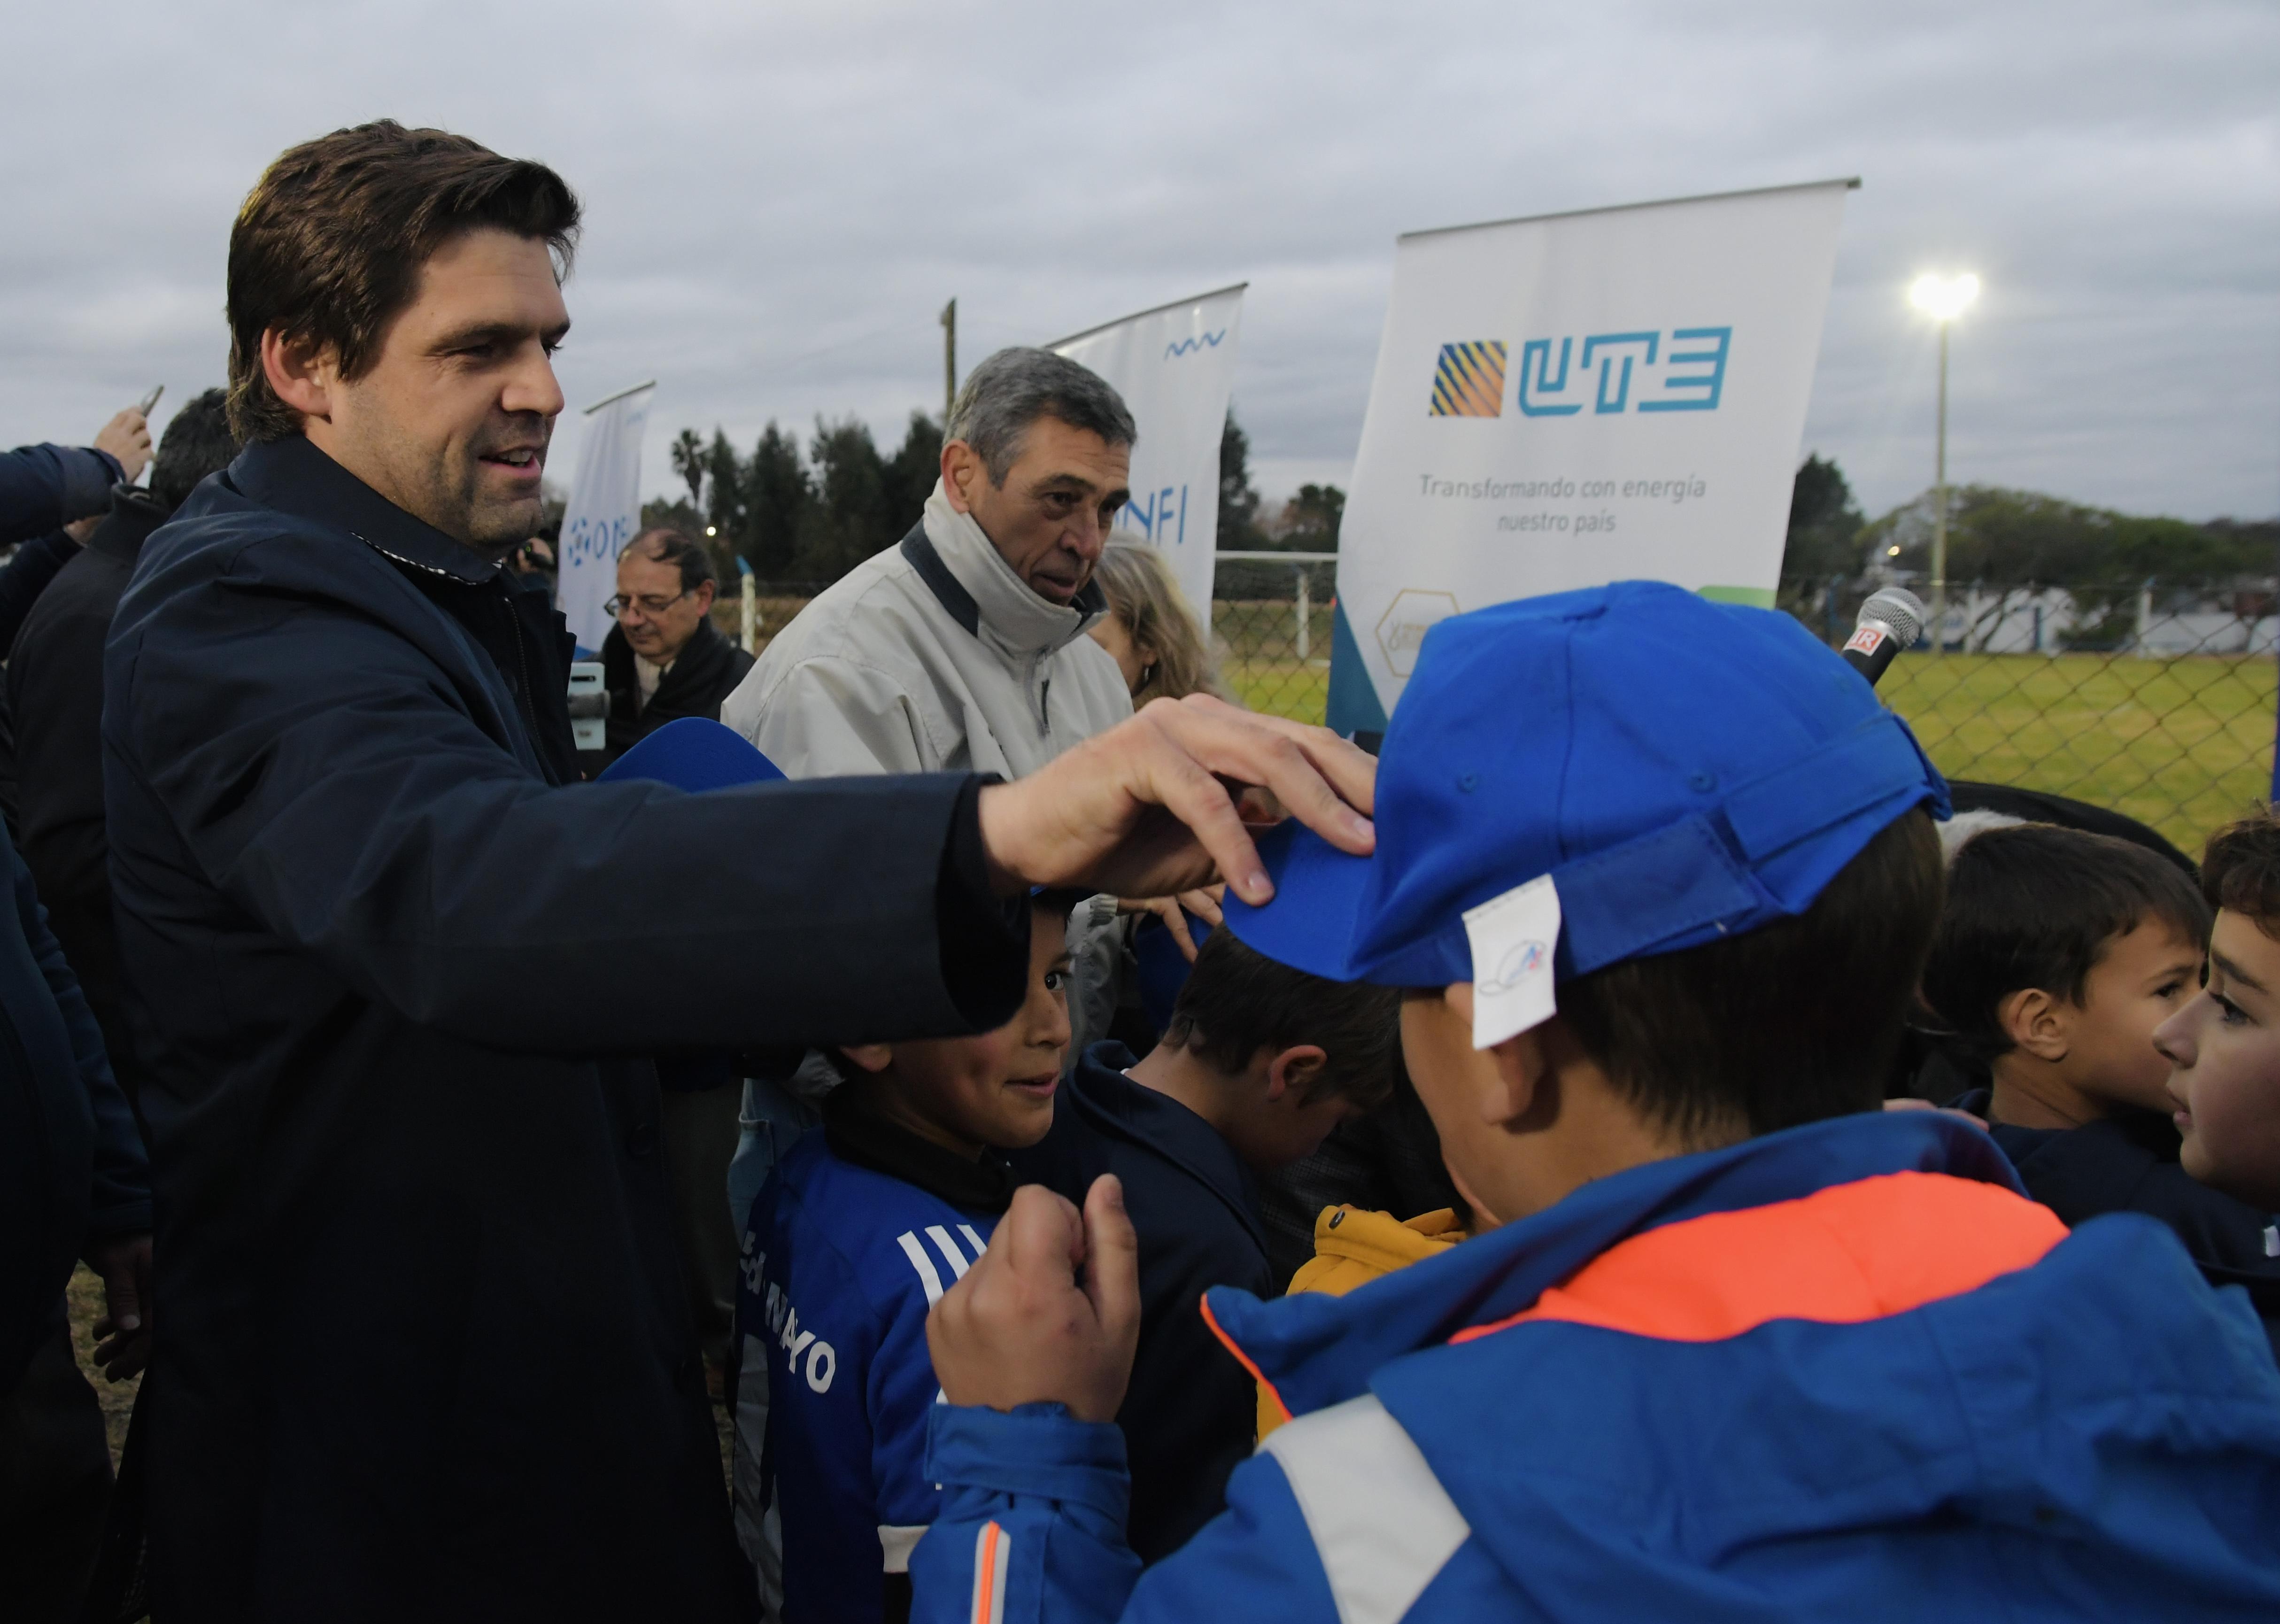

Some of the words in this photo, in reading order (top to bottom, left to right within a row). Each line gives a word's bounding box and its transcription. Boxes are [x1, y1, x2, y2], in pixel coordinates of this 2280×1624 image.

[1519, 327, 1732, 417] UTE
[1420, 474, 1576, 499] Transformando
[1581, 479, 1615, 498] con
[1623, 472, 1707, 504] energía
[1497, 511, 1569, 532] nuestro
[1573, 509, 1617, 536] país
